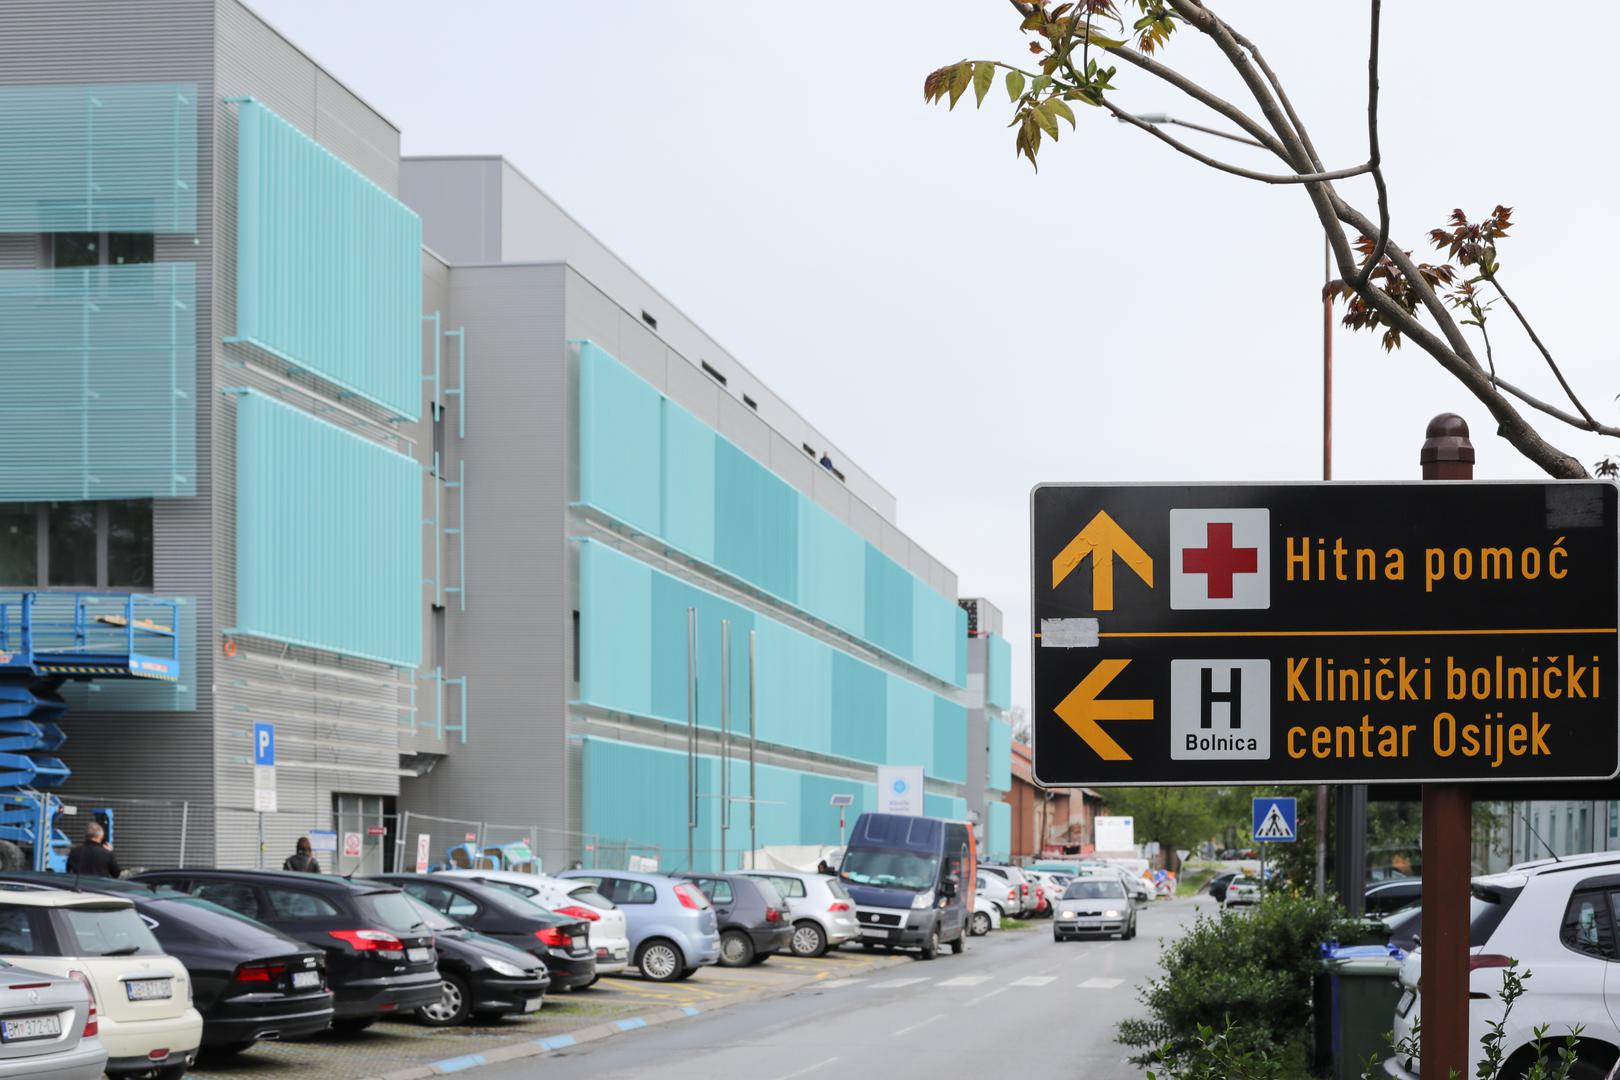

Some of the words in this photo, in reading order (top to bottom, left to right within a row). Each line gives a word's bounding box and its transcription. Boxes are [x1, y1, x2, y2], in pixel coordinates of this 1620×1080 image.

[1286, 536, 1405, 581] Hitna
[1425, 536, 1568, 593] pomoć
[1200, 667, 1242, 730] H
[1286, 656, 1431, 702] Klinički
[1447, 654, 1600, 701] bolnički
[258, 729, 270, 758] P
[1185, 733, 1257, 752] Bolnica
[1287, 714, 1417, 759] centar
[1433, 711, 1551, 768] Osijek
